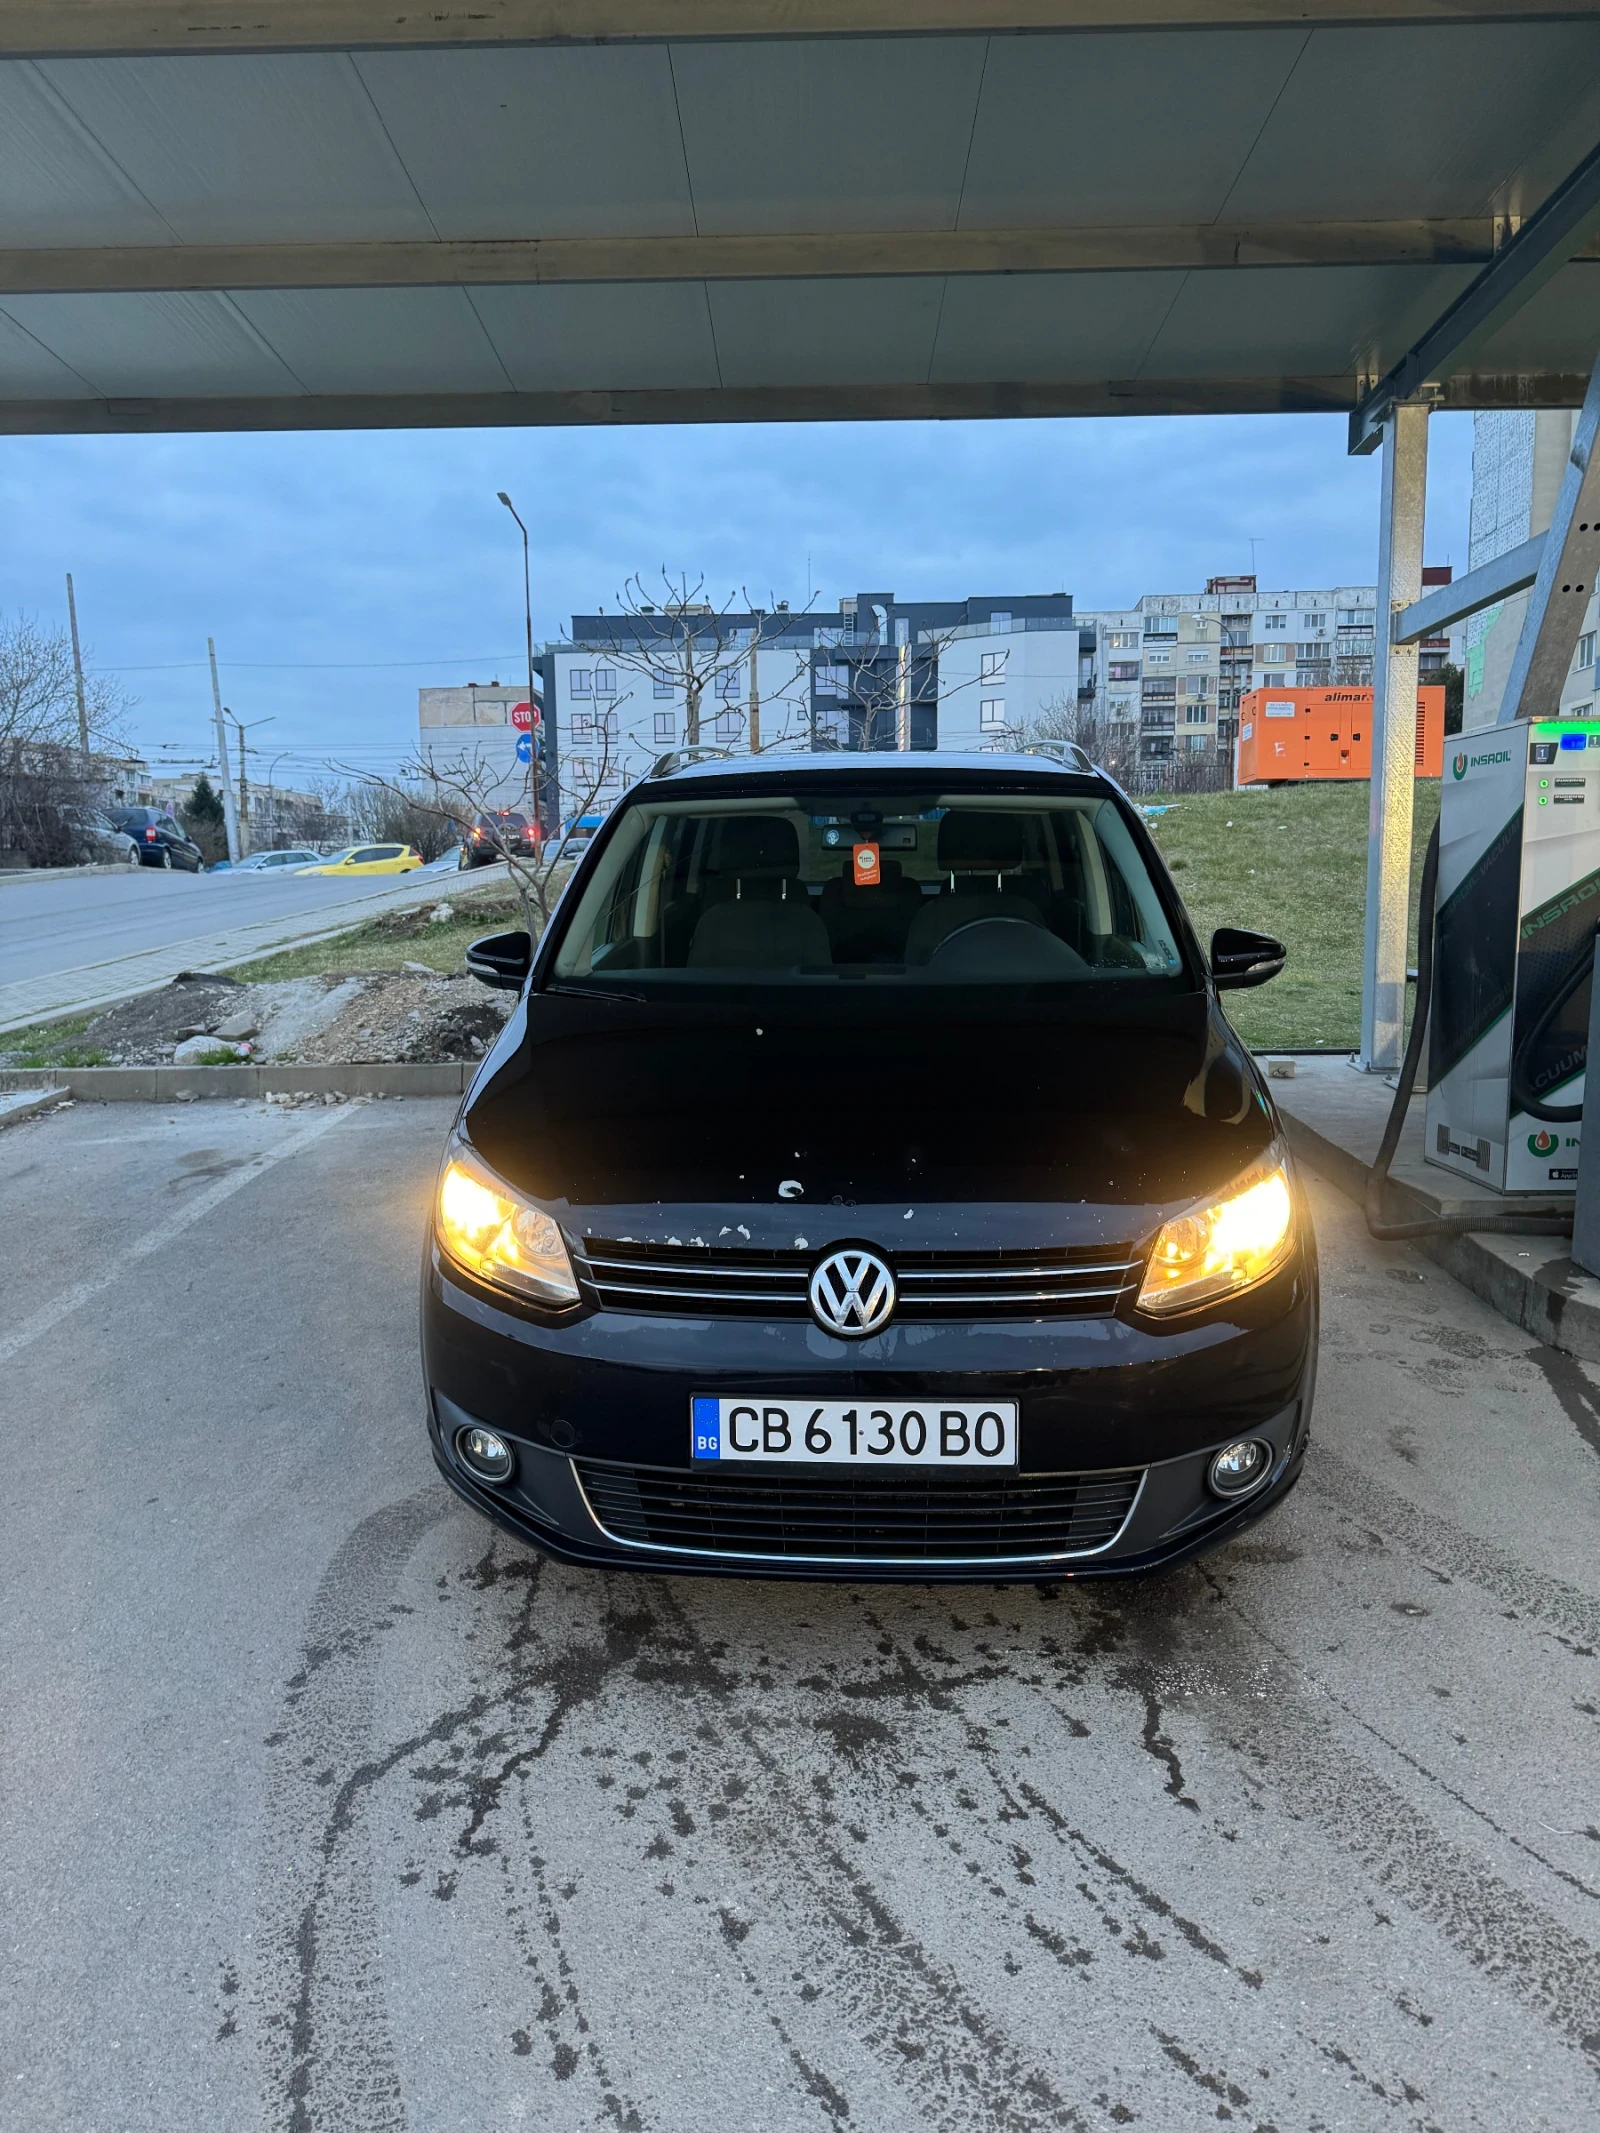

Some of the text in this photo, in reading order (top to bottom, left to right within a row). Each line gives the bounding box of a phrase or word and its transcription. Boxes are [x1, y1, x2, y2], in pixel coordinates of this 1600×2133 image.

[697, 1436, 718, 1450] BG
[729, 1407, 1006, 1457] CB 6130 BO
